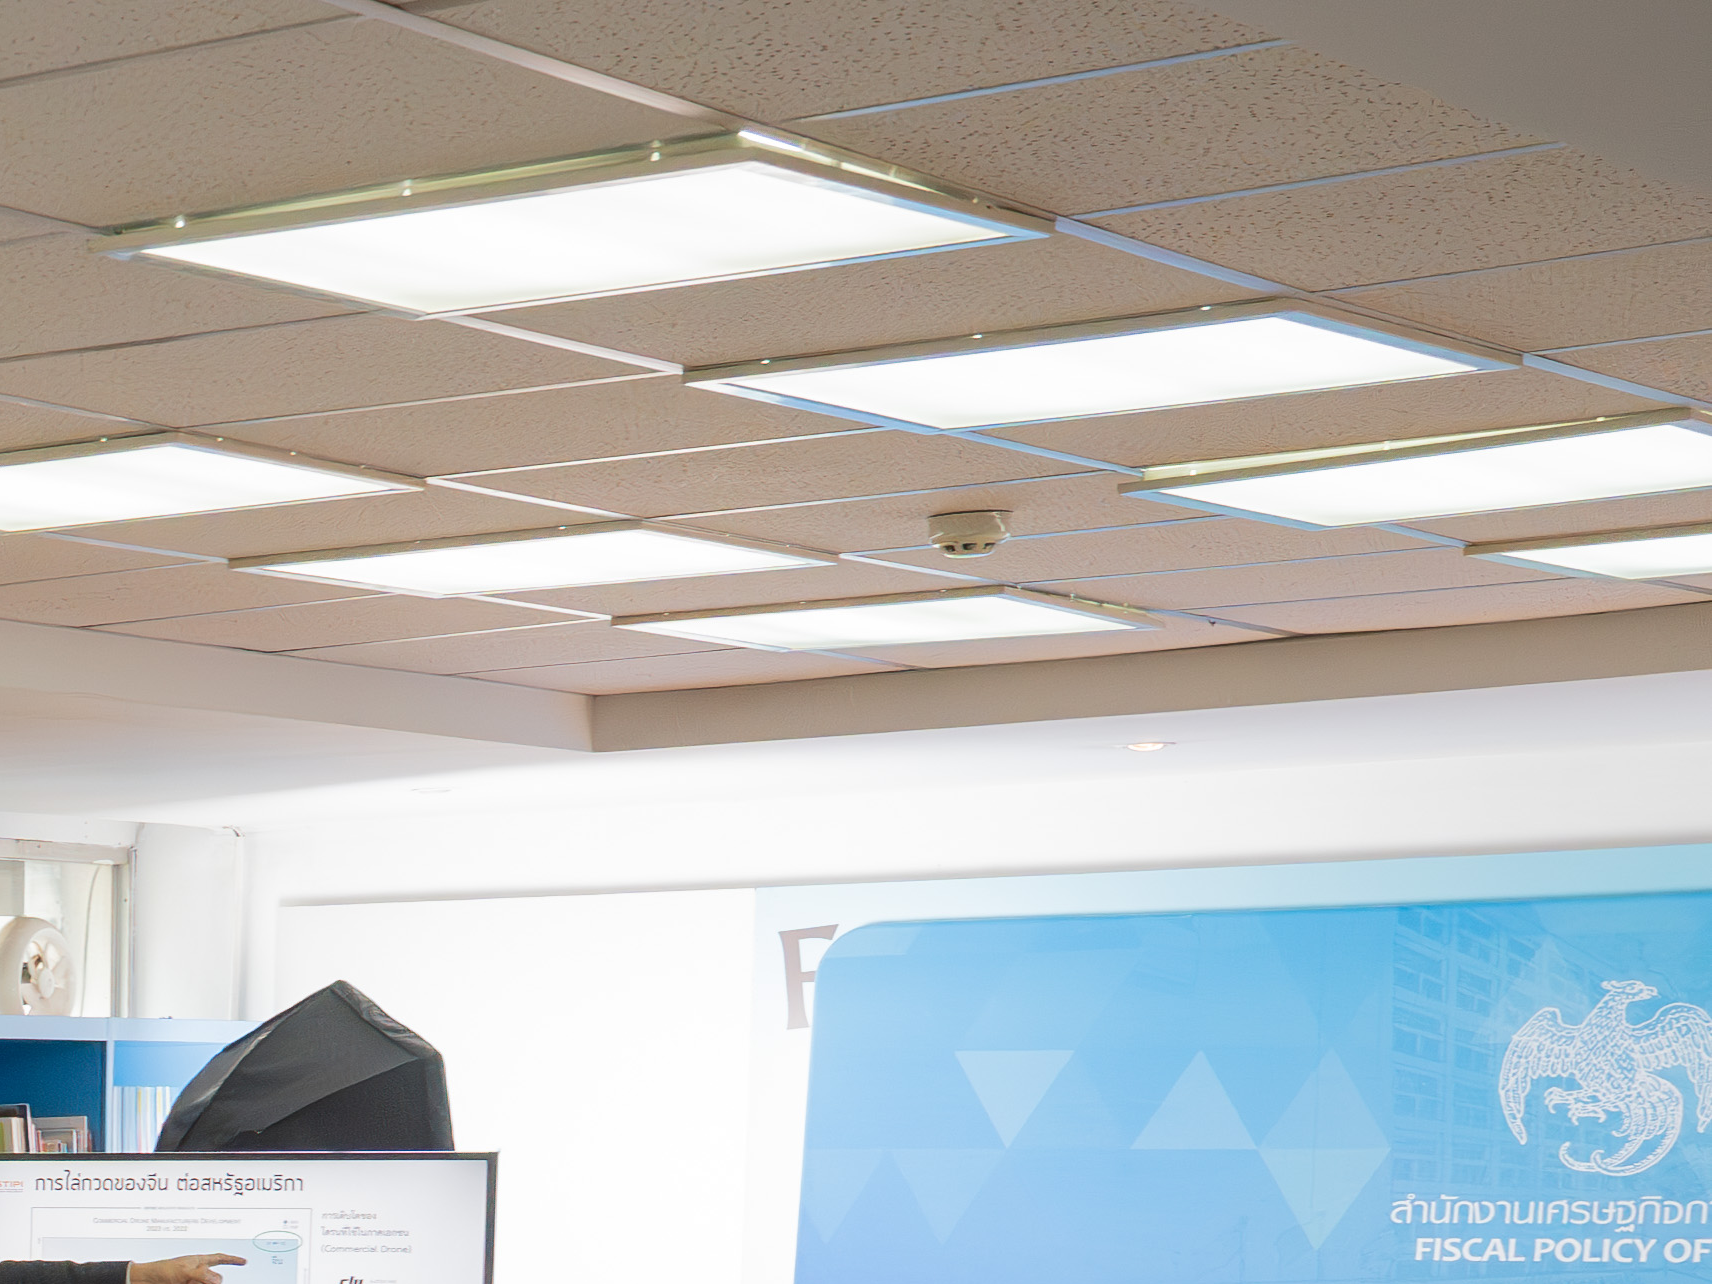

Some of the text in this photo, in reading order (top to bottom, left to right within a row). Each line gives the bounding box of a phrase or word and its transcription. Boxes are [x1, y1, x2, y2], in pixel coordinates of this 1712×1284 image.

[35, 1170, 305, 1196] การไล่กวดของจีน ต่อสหรัฐอเมริกา
[1414, 1238, 1525, 1261] FISCAL
[1533, 1238, 1657, 1263] POLICY
